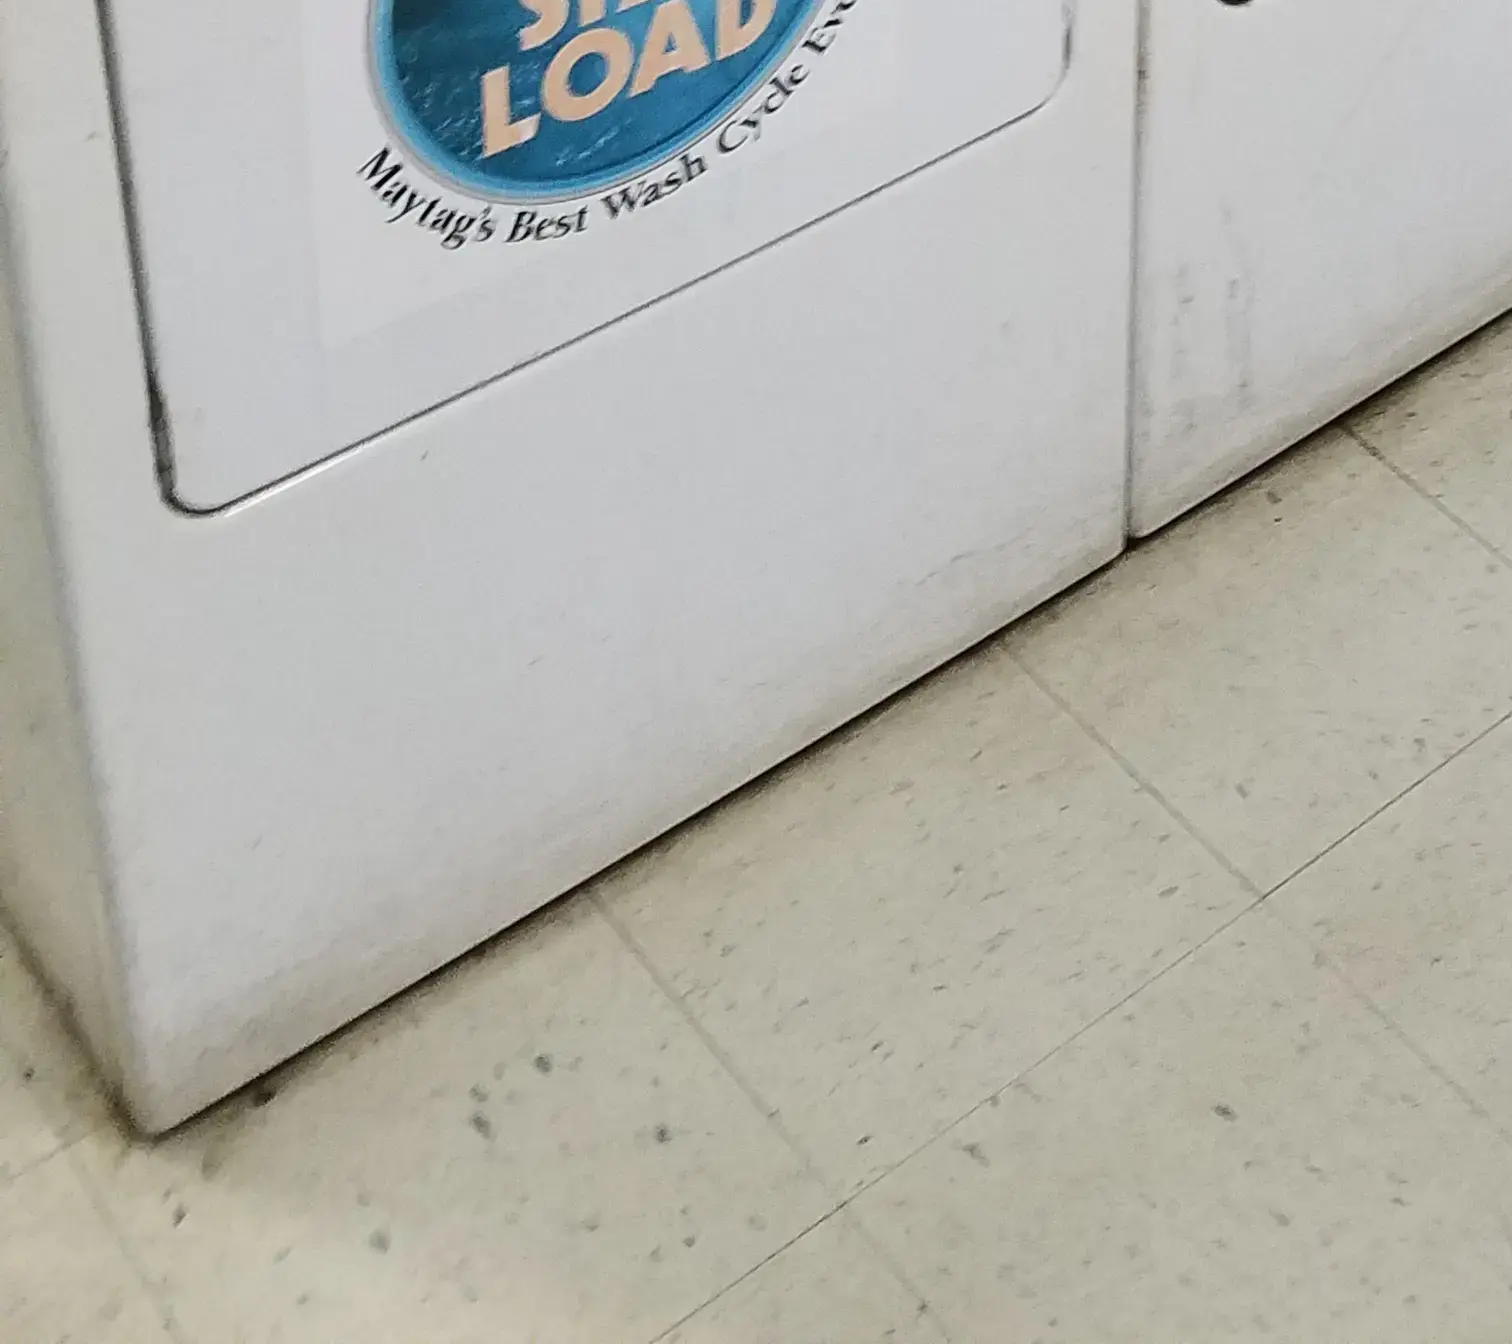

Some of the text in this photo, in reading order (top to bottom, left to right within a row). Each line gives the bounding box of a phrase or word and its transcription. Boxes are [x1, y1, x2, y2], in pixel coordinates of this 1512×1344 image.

[357, 147, 496, 251] Maytag's
[503, 204, 588, 245] Best
[600, 153, 708, 221] Wash
[718, 62, 808, 156] Cycle
